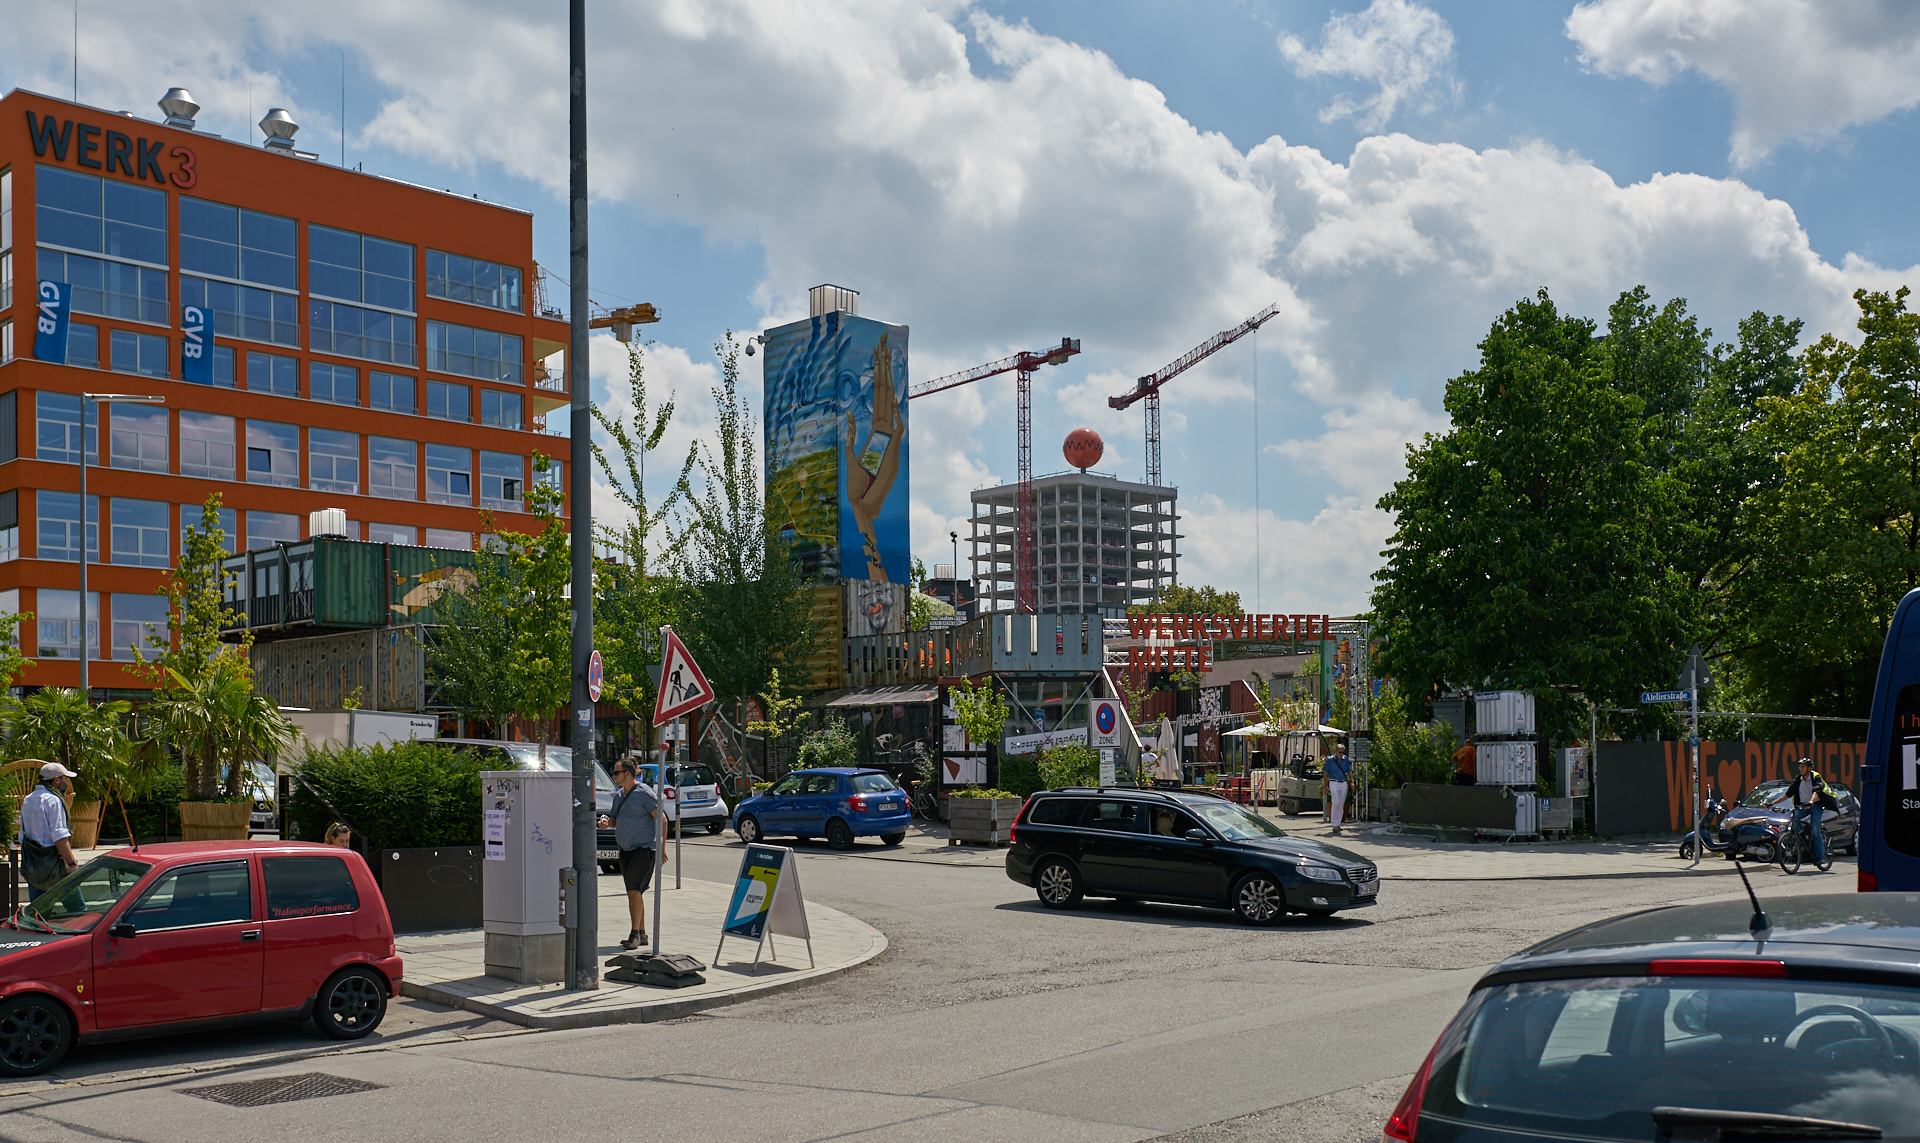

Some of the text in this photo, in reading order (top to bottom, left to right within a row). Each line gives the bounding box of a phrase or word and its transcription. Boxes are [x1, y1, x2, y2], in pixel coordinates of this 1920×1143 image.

[38, 281, 60, 335] GVB
[184, 306, 204, 359] GVB
[1127, 612, 1337, 641] WERKSVIERTEL
[1129, 646, 1213, 672] MITTE
[1645, 692, 1688, 702] Atelierstraße
[1098, 736, 1114, 744] ZONE
